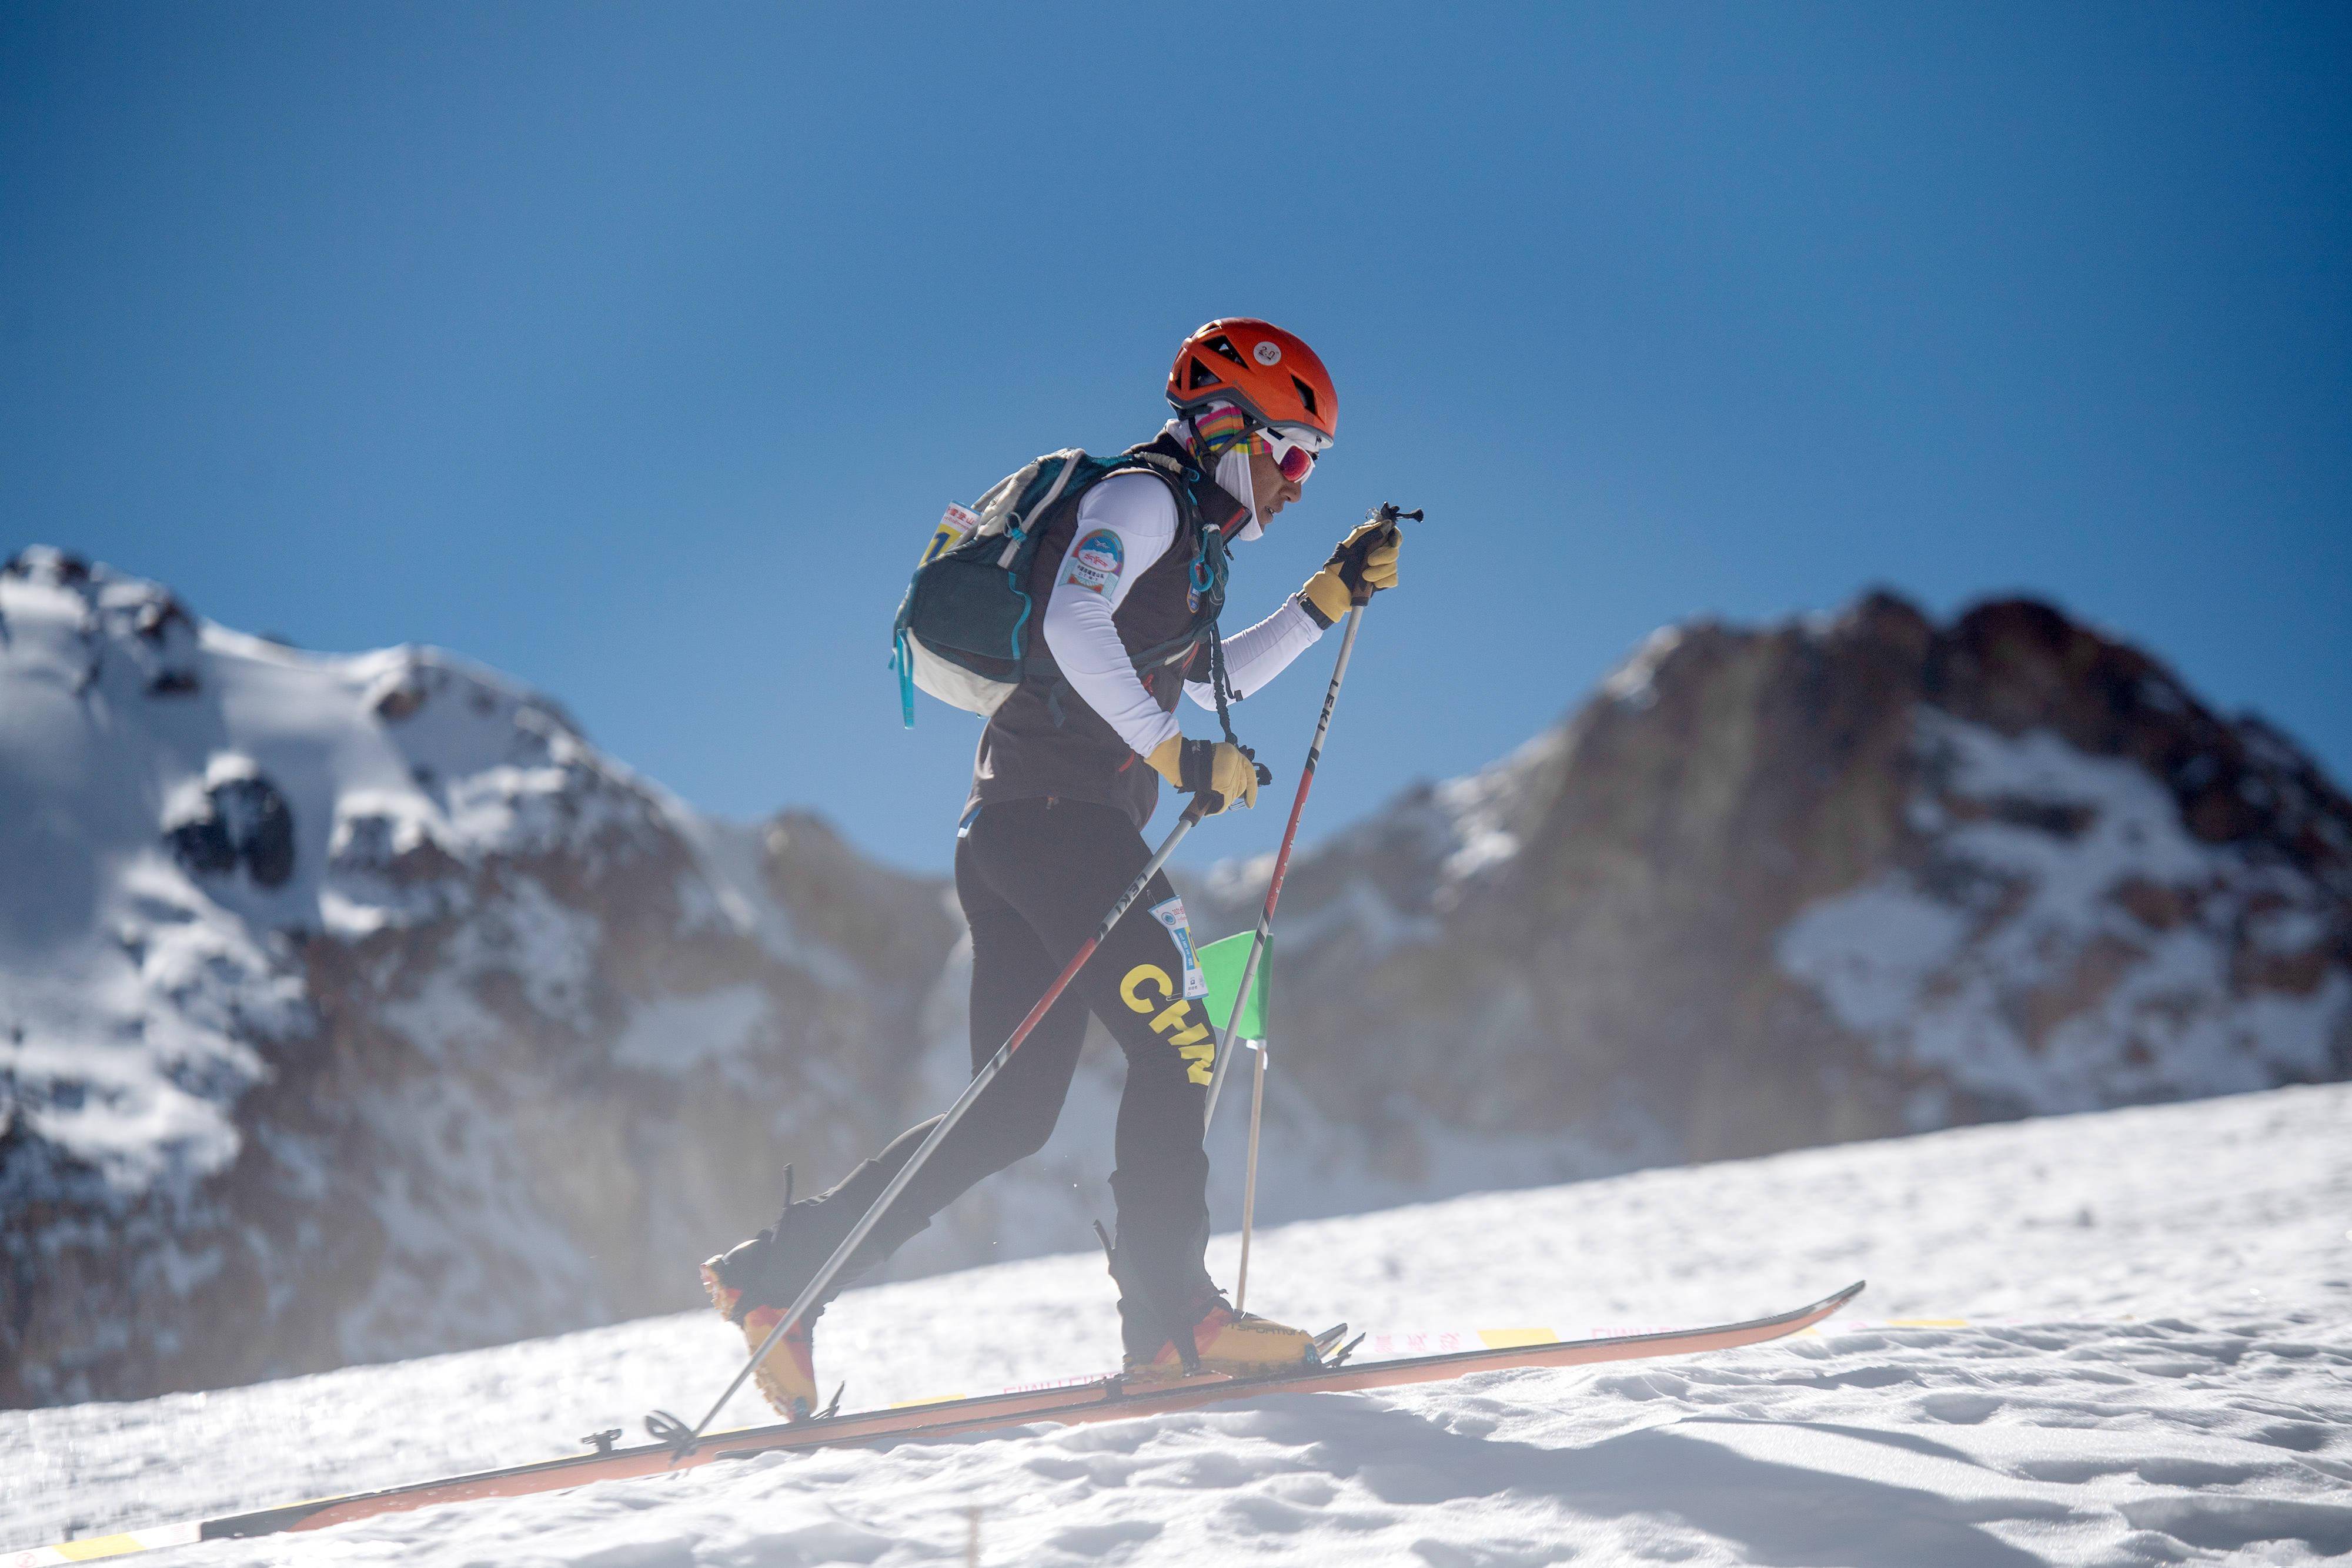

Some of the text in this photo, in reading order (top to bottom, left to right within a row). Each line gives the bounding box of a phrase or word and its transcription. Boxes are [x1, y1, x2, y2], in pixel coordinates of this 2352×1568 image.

[1317, 678, 1339, 732] LEKI
[1115, 872, 1148, 915] LEKI
[1120, 964, 1215, 1086] CHN
